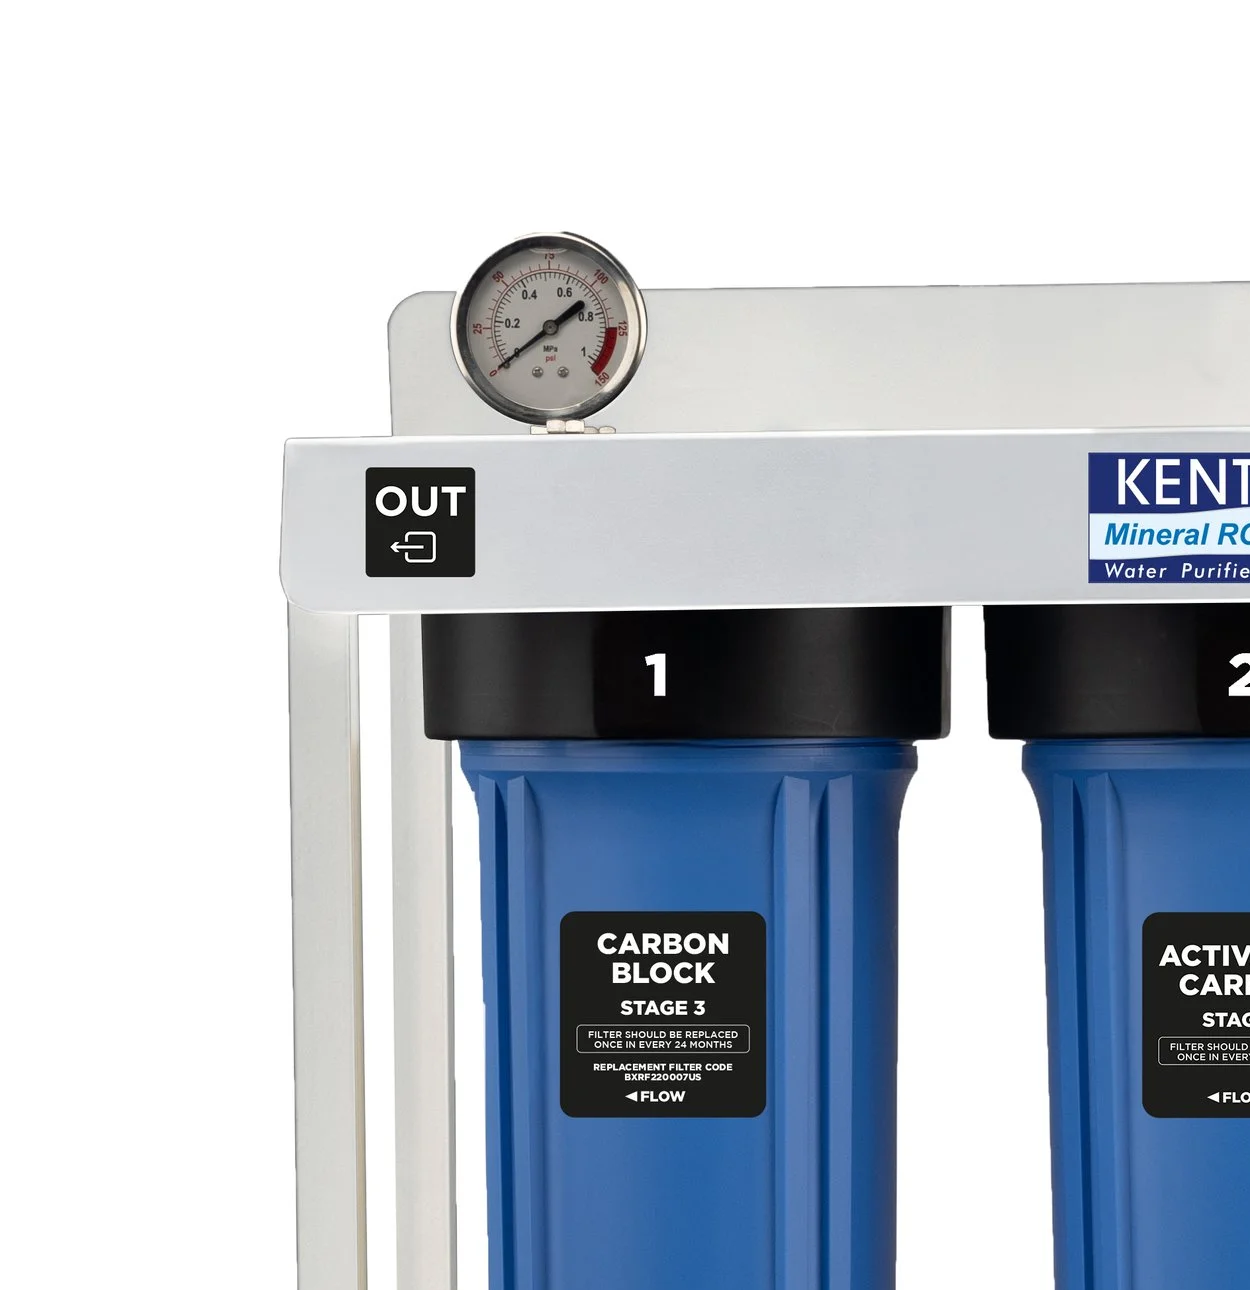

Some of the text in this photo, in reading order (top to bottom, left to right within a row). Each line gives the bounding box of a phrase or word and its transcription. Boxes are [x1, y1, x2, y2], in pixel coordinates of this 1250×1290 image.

[492, 271, 504, 283] 50
[593, 269, 608, 284] 100
[522, 290, 537, 299] 0.4
[557, 288, 572, 297] 0.6
[579, 312, 593, 322] 0.8
[473, 323, 482, 334] 25
[505, 319, 520, 328] 0.2
[618, 320, 627, 336] 125
[581, 347, 586, 356] 1
[545, 355, 556, 363] psi
[595, 372, 609, 386] 150
[376, 486, 466, 516] OUT
[1105, 523, 1209, 545] Mineral
[1105, 562, 1167, 578] Water
[645, 654, 665, 696] 1
[597, 933, 728, 954] CARBON
[613, 962, 715, 984] BLOCK
[620, 1000, 705, 1015] STAGE 3
[1177, 1053, 1206, 1061] ONCE
[594, 1063, 732, 1071] REPLACEMENT FILTER CODE
[625, 1073, 701, 1081] BXRF220007US
[641, 1091, 686, 1102] FLOW
